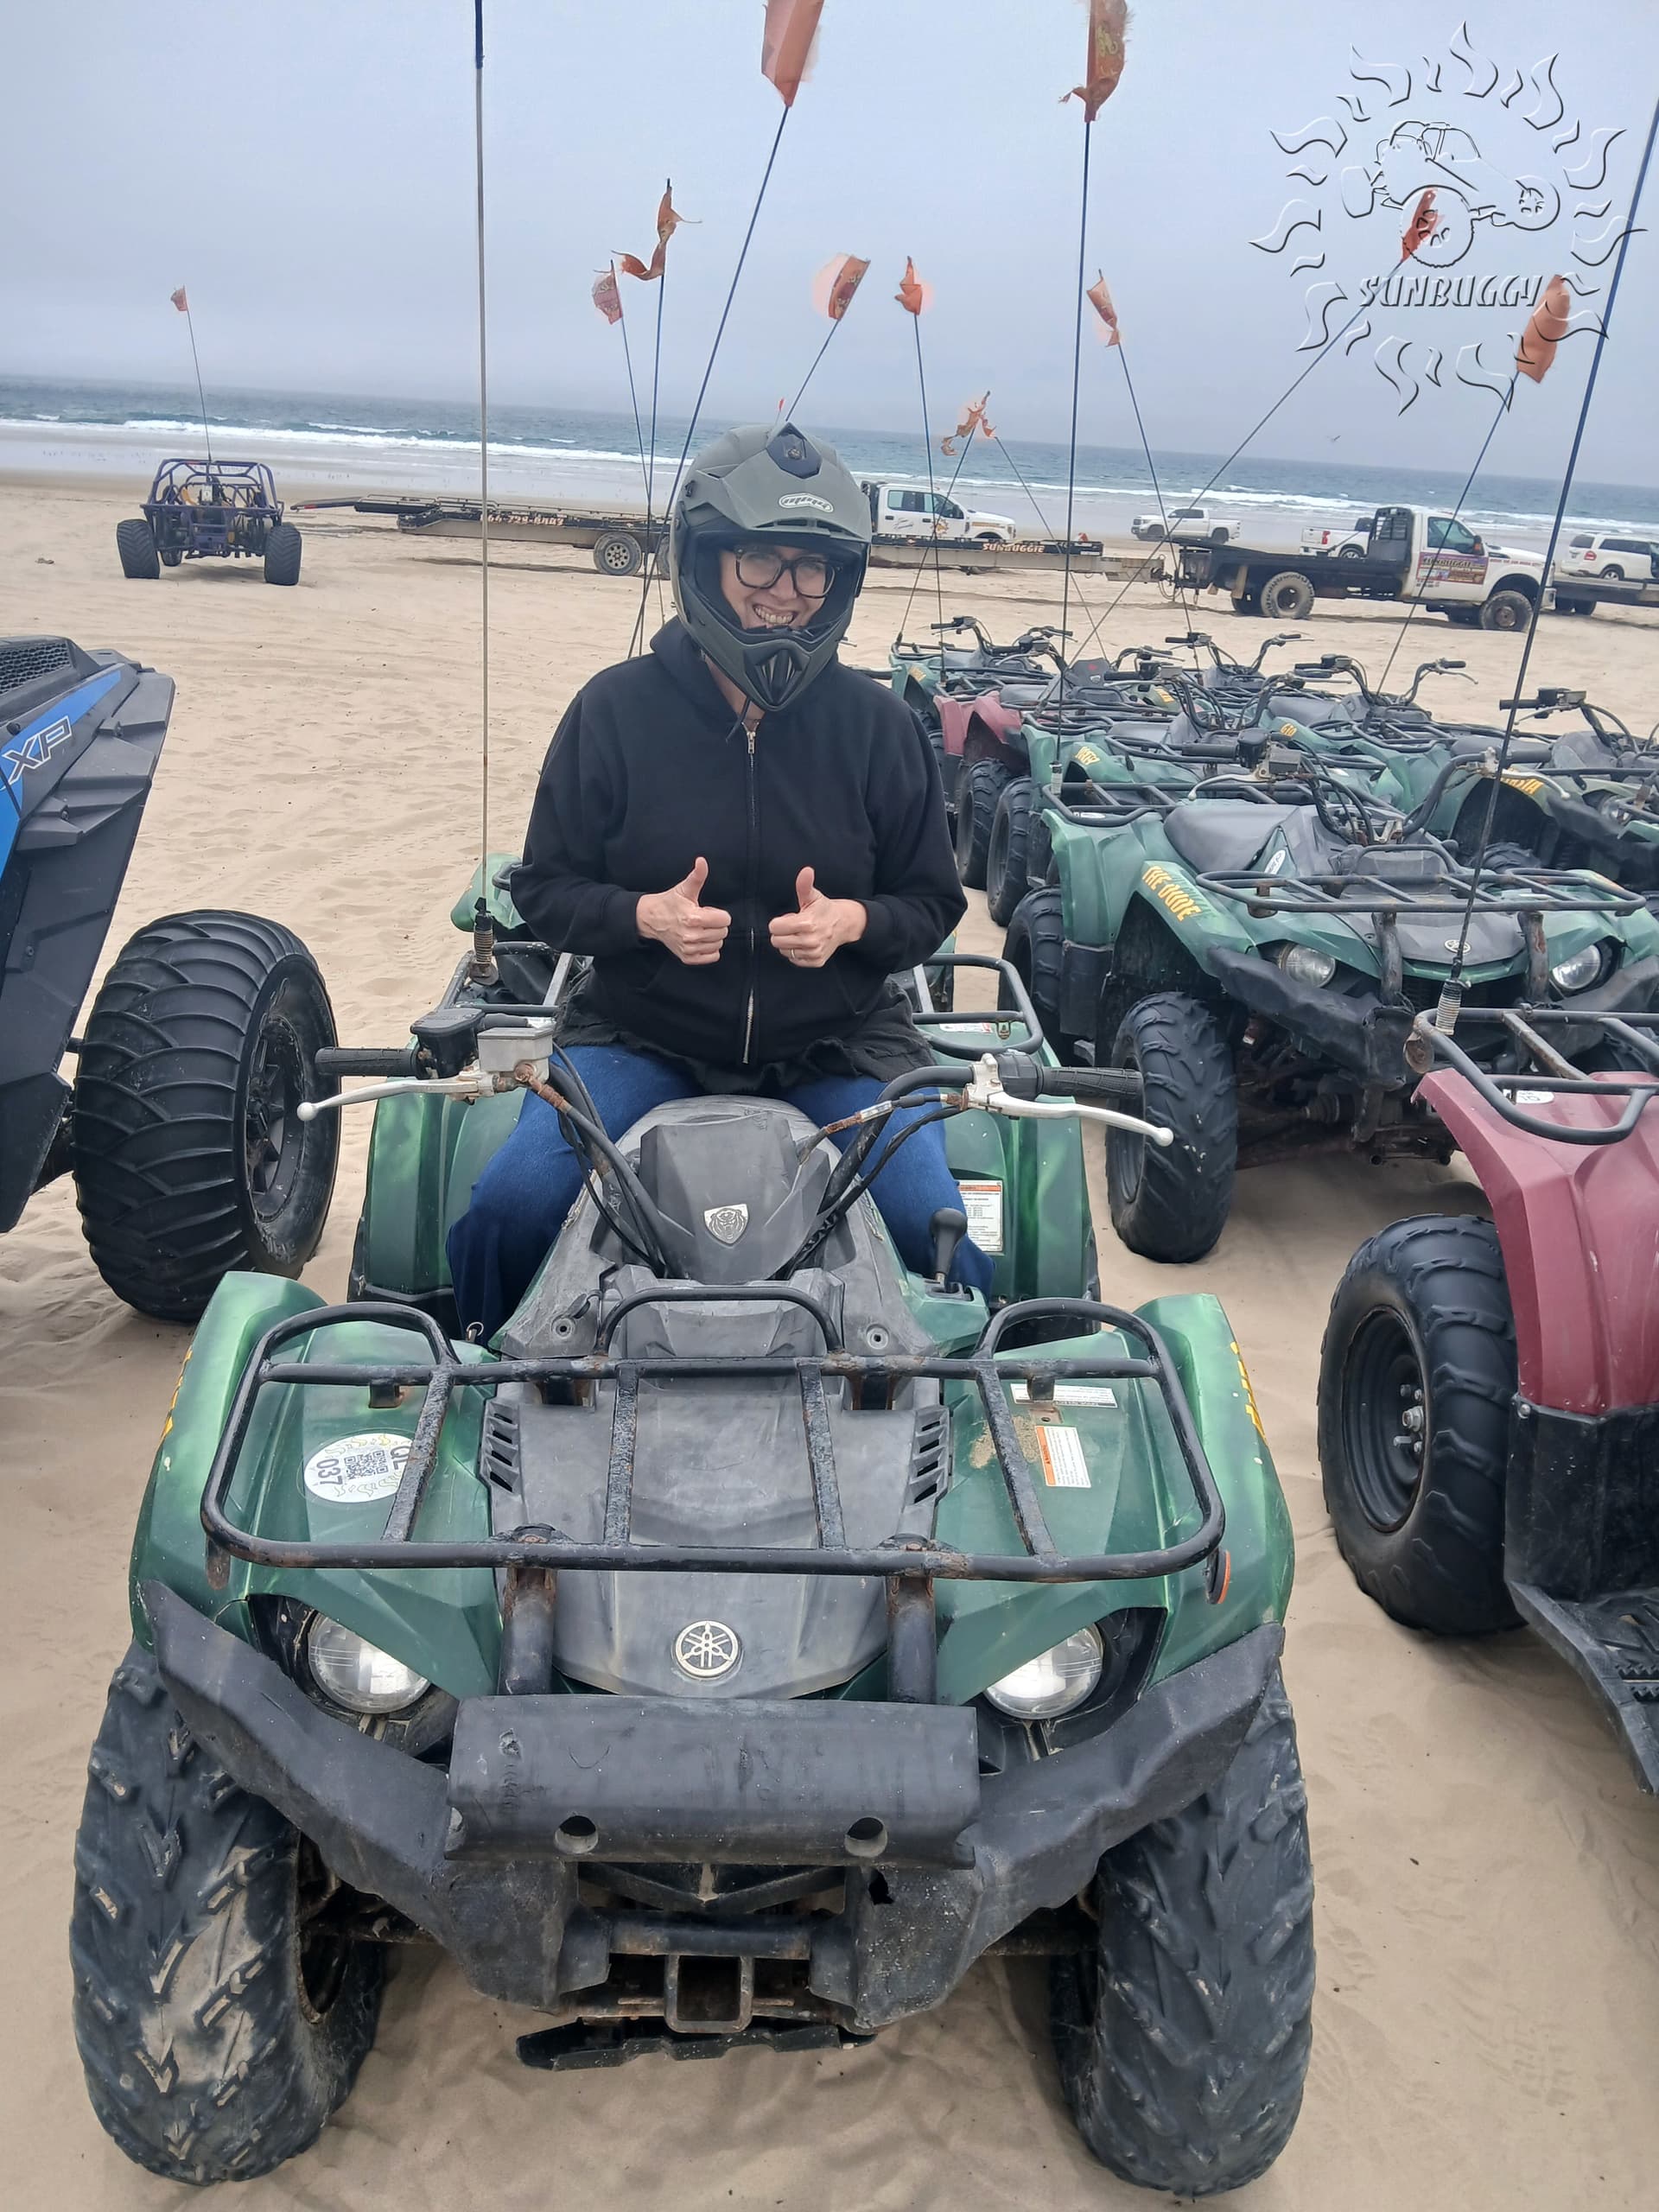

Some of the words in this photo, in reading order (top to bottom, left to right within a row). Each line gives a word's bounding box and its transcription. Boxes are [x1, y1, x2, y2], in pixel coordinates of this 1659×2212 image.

[1, 715, 73, 786] XP
[1141, 866, 1173, 892] THE
[1157, 883, 1203, 922] DUDE
[316, 1458, 343, 1485] 037
